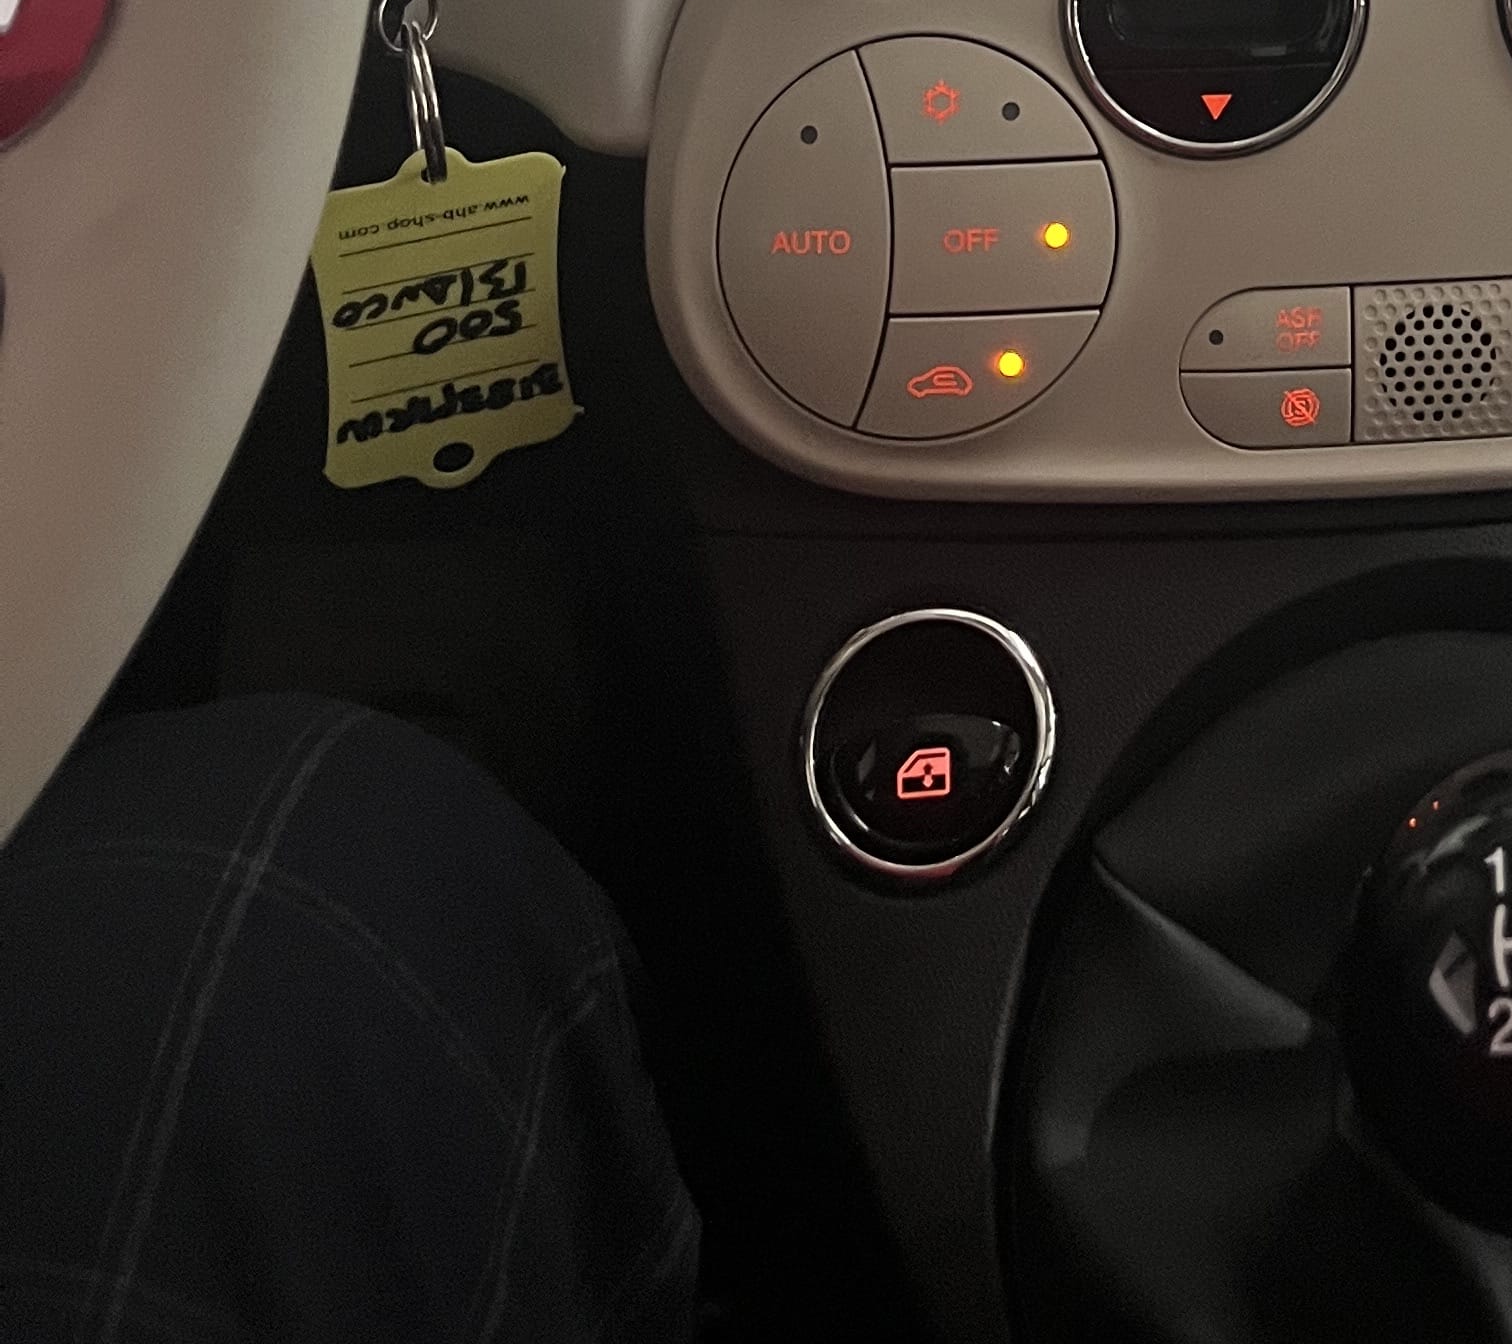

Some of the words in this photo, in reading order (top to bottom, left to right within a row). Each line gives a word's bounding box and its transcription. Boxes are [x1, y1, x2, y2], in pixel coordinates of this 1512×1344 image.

[771, 230, 851, 255] AUTO
[943, 229, 999, 253] OFF
[413, 300, 524, 355] 500
[1276, 330, 1321, 352] OFF
[1484, 846, 1505, 894] 1
